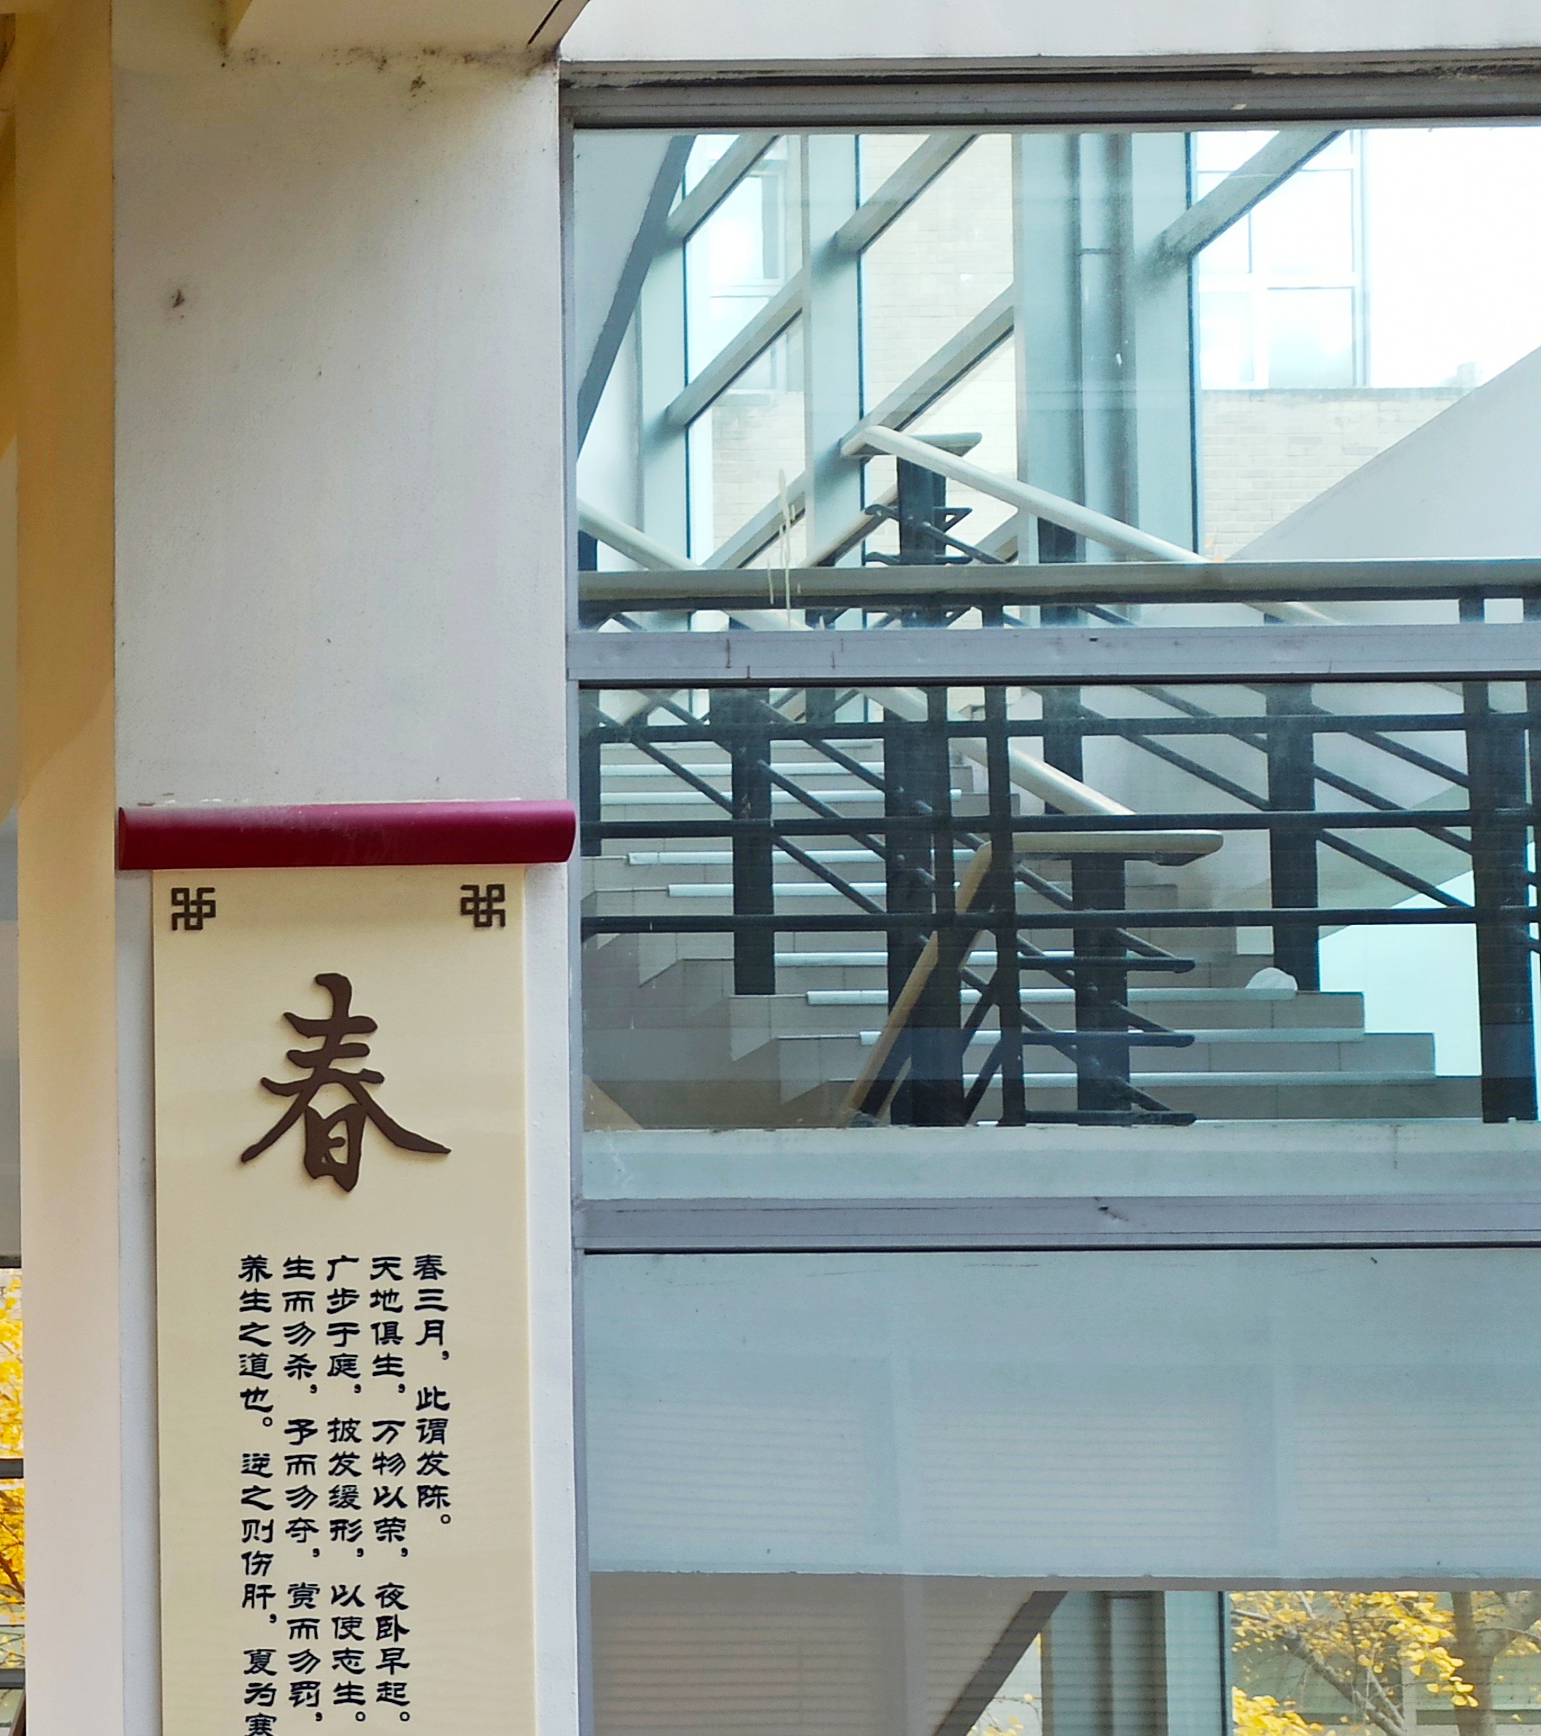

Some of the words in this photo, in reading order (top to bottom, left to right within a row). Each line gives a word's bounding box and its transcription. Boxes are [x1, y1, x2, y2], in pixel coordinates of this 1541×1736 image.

[240, 973, 452, 1193] 春
[326, 1255, 367, 1722] 广步于庭，披发缓形，以使志生。
[370, 1257, 411, 1722] 天地俱生，万物以荣，夜卧早起。
[413, 1254, 451, 1525] 春三月，此谓发陈。
